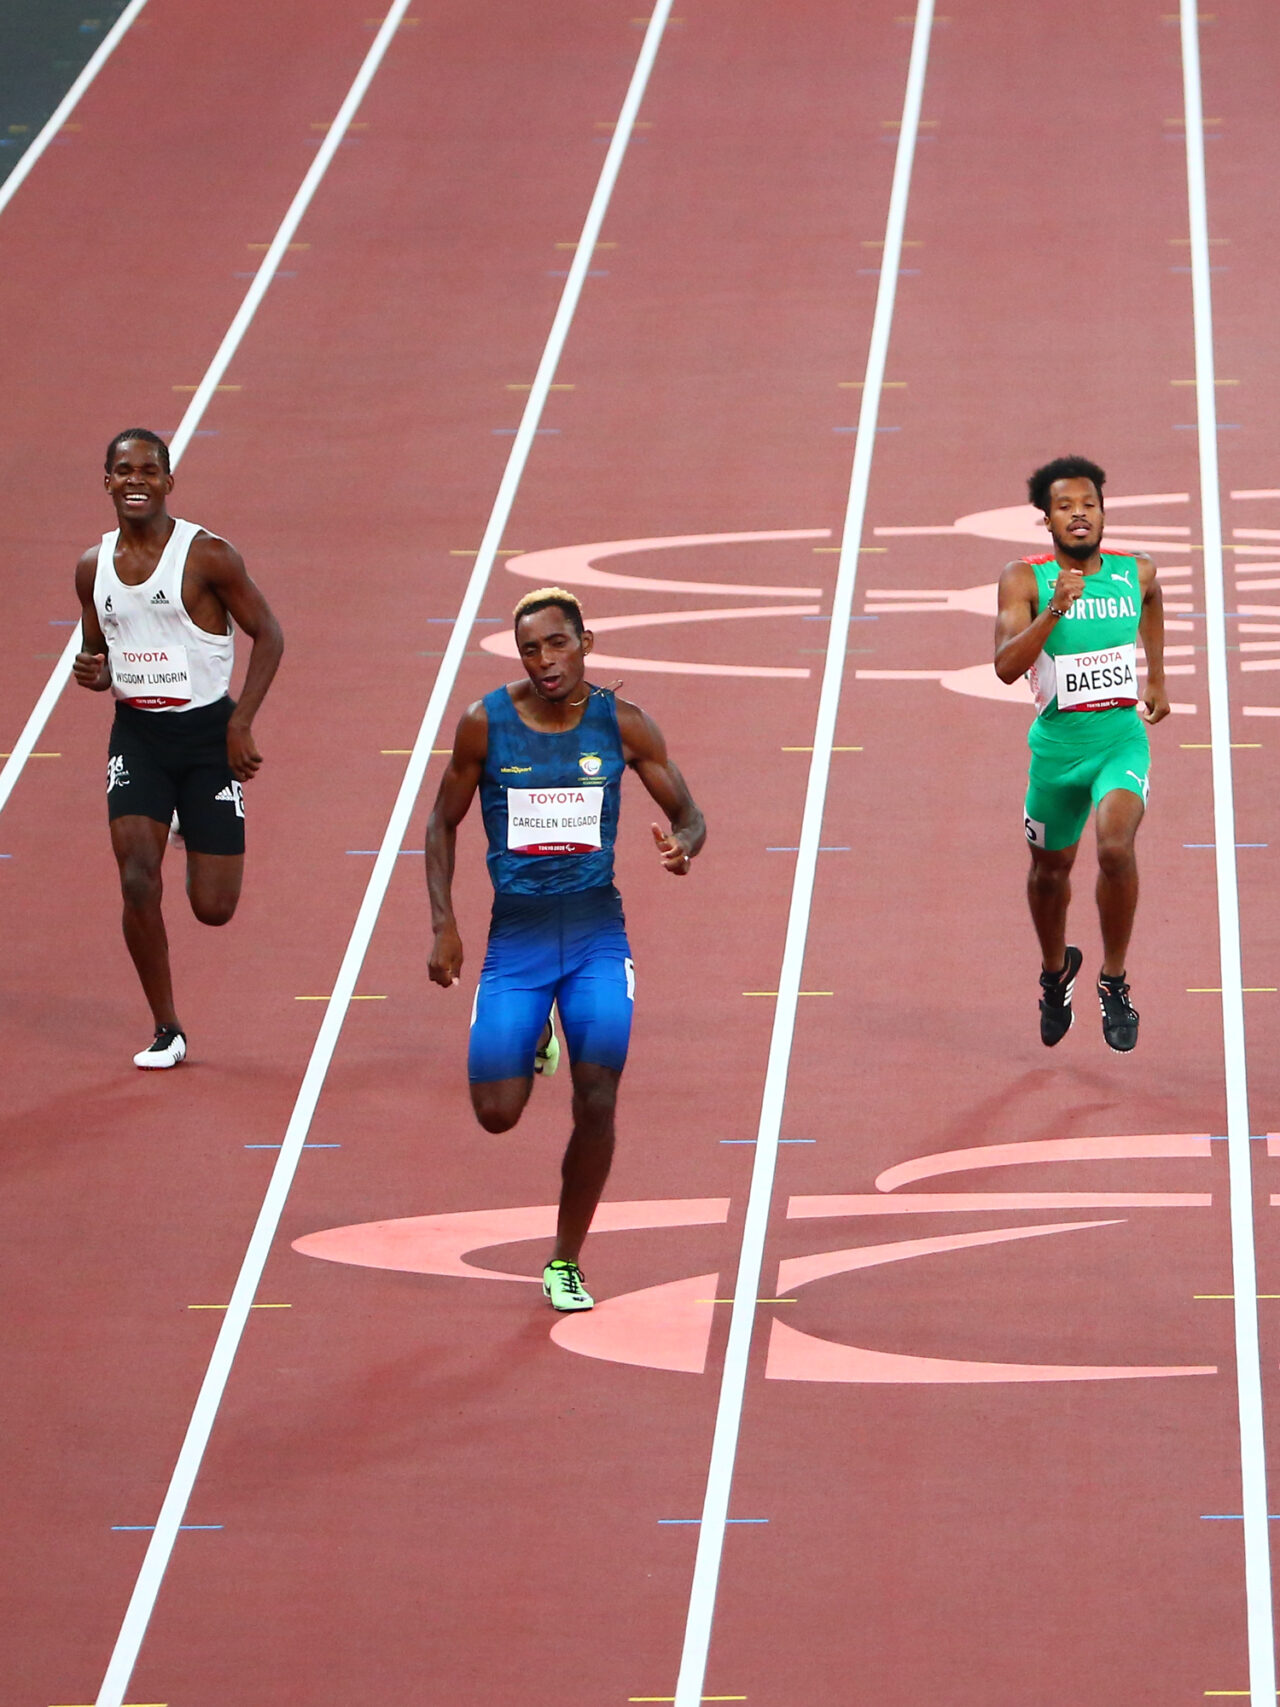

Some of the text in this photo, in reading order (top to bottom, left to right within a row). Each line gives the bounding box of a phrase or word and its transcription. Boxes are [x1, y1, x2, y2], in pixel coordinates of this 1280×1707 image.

[1064, 596, 1137, 620] ORTUGAL
[122, 652, 169, 662] TOYOTA
[1074, 651, 1122, 668] TOYOTA
[116, 671, 188, 684] WISDOM LUNGRIN
[1066, 664, 1134, 693] BAESSA
[528, 792, 585, 804] TOYOTA
[512, 815, 598, 828] CARCELEN DELGADO
